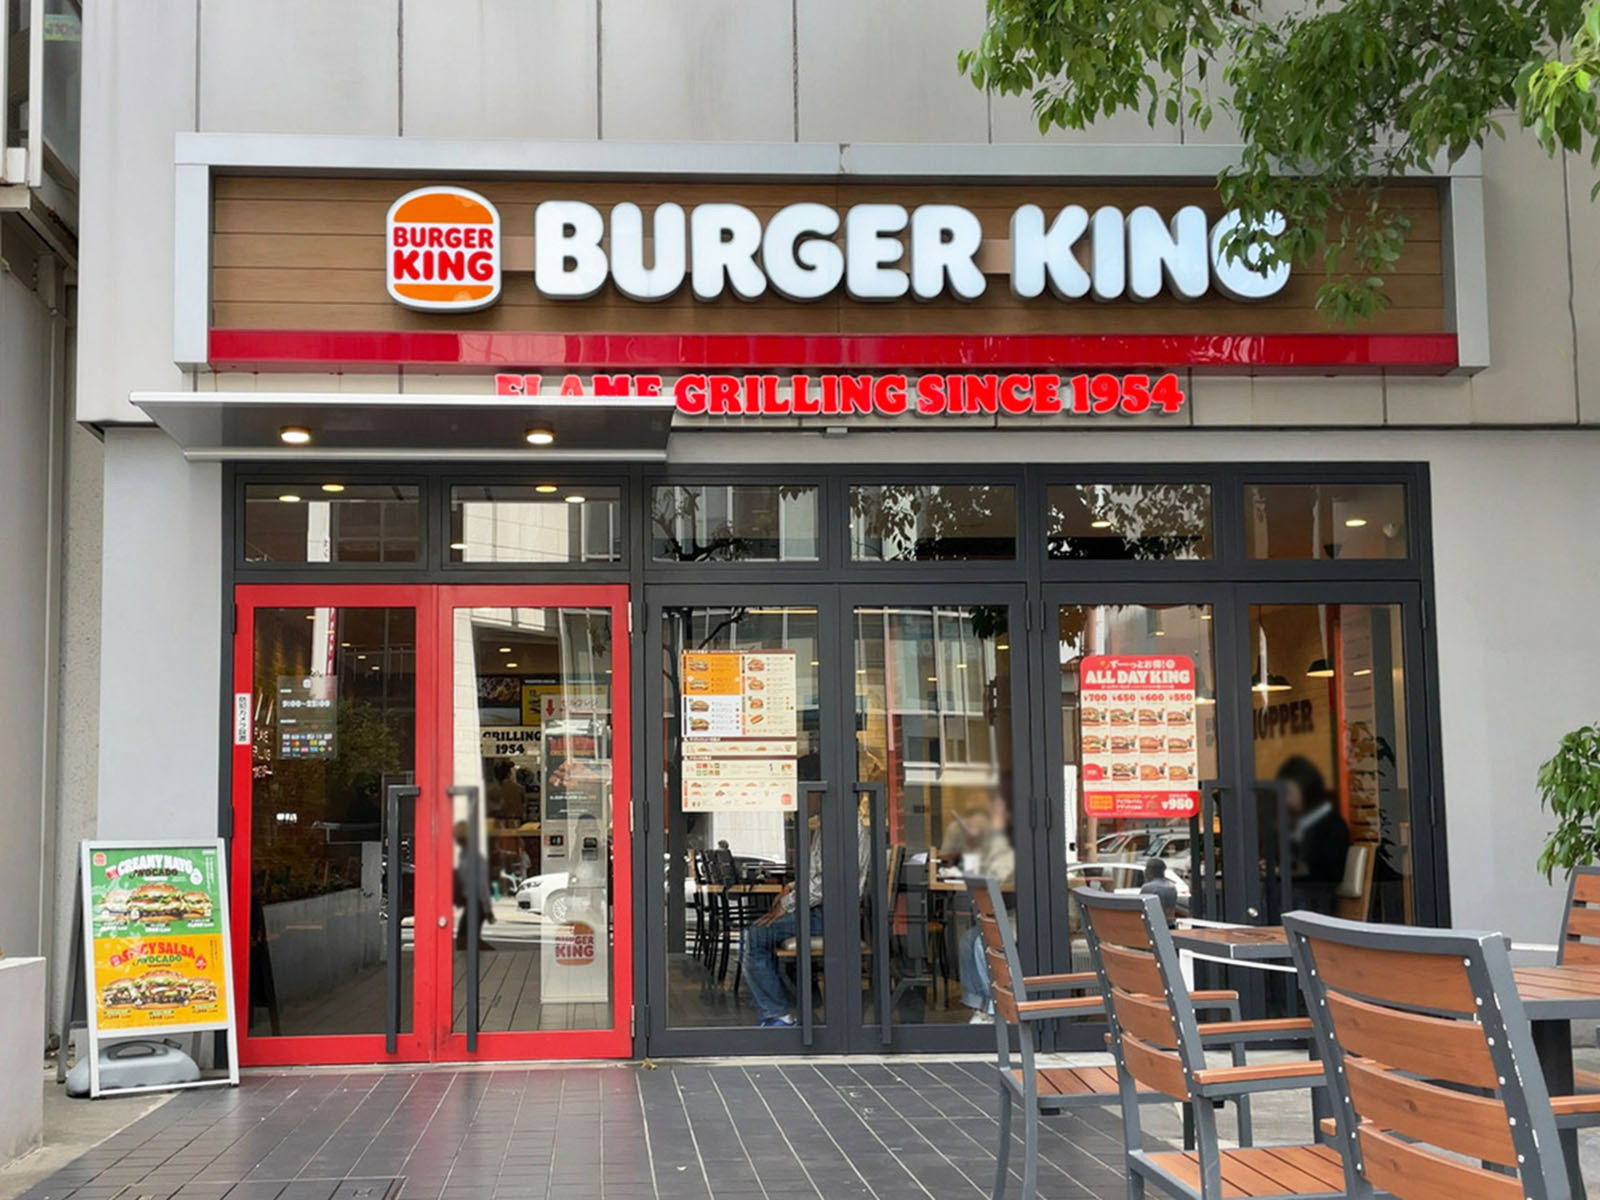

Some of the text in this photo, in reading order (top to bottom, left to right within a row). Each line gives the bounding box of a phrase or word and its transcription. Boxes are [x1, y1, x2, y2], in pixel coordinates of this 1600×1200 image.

[393, 227, 494, 249] BURGER
[534, 200, 1292, 299] BURGER KING
[393, 251, 494, 281] KING
[673, 375, 907, 414] GRILLING
[915, 374, 1062, 414] SINCE
[1070, 374, 1185, 414] 1954
[1085, 670, 1190, 684] ALL DAY KING
[496, 744, 525, 754] 1954
[129, 868, 179, 879] AVOCADO
[157, 942, 195, 959] SALSA
[555, 944, 594, 957] KING
[132, 955, 182, 966] AVOCADO
